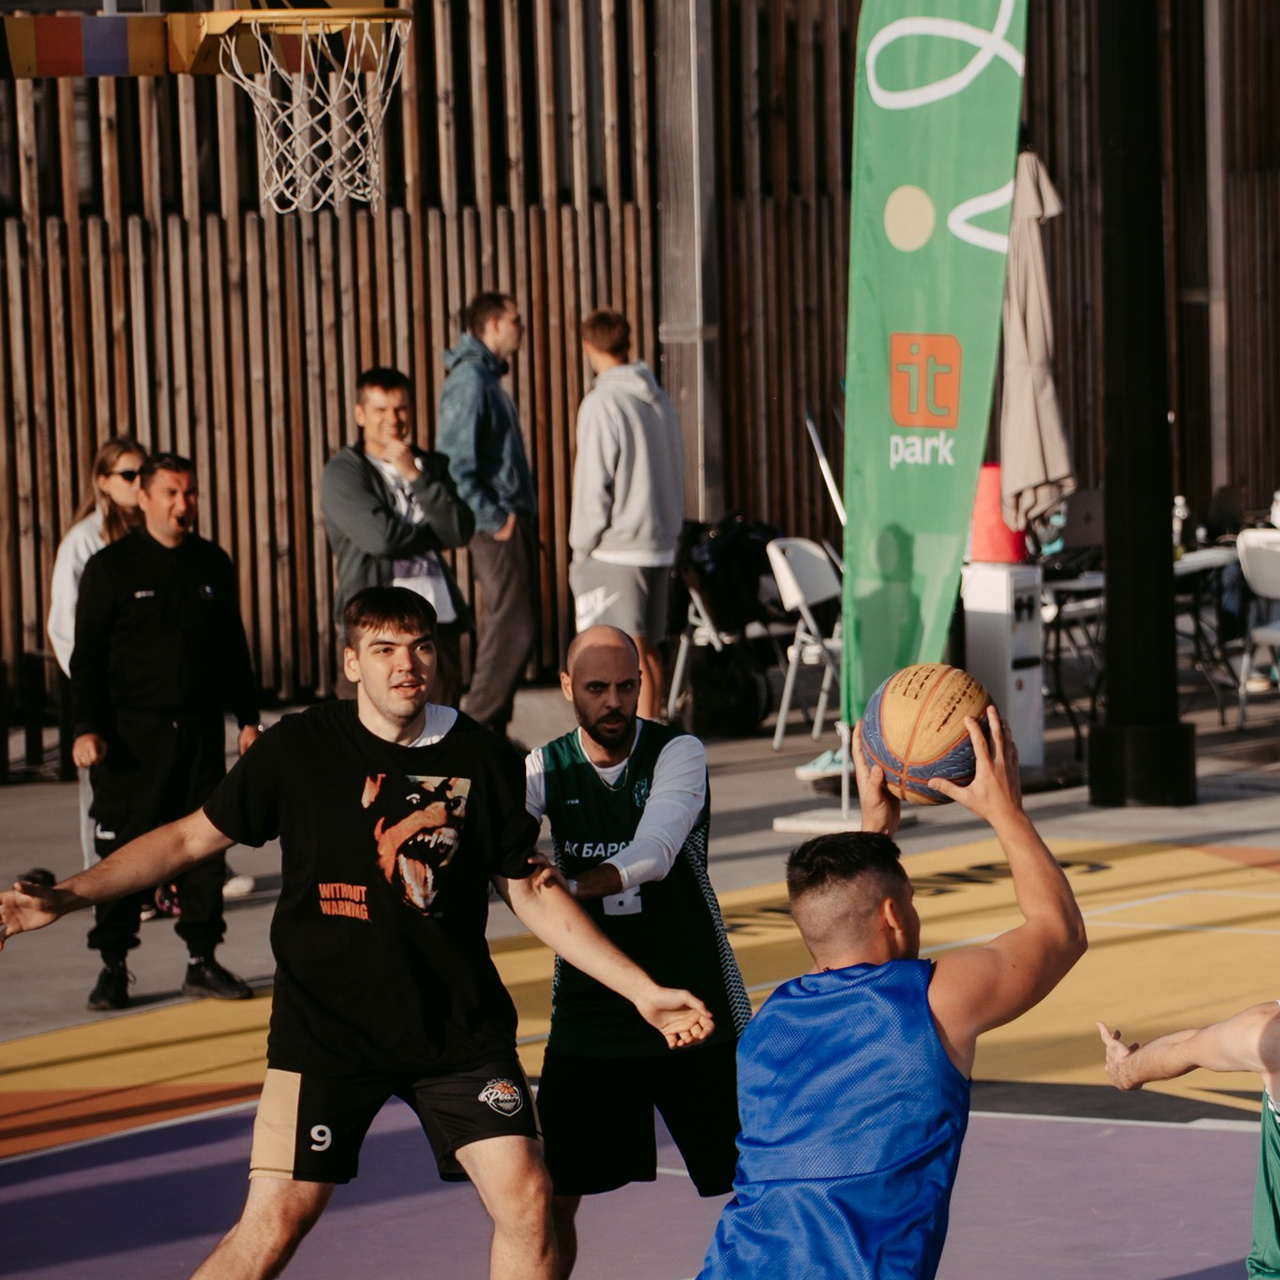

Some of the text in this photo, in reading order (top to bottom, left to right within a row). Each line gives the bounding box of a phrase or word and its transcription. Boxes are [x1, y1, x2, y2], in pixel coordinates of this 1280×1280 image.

[896, 343, 951, 416] it
[889, 430, 955, 471] park
[318, 882, 367, 902] WITHOUT
[319, 899, 369, 921] WARNING
[310, 1124, 332, 1152] 9
